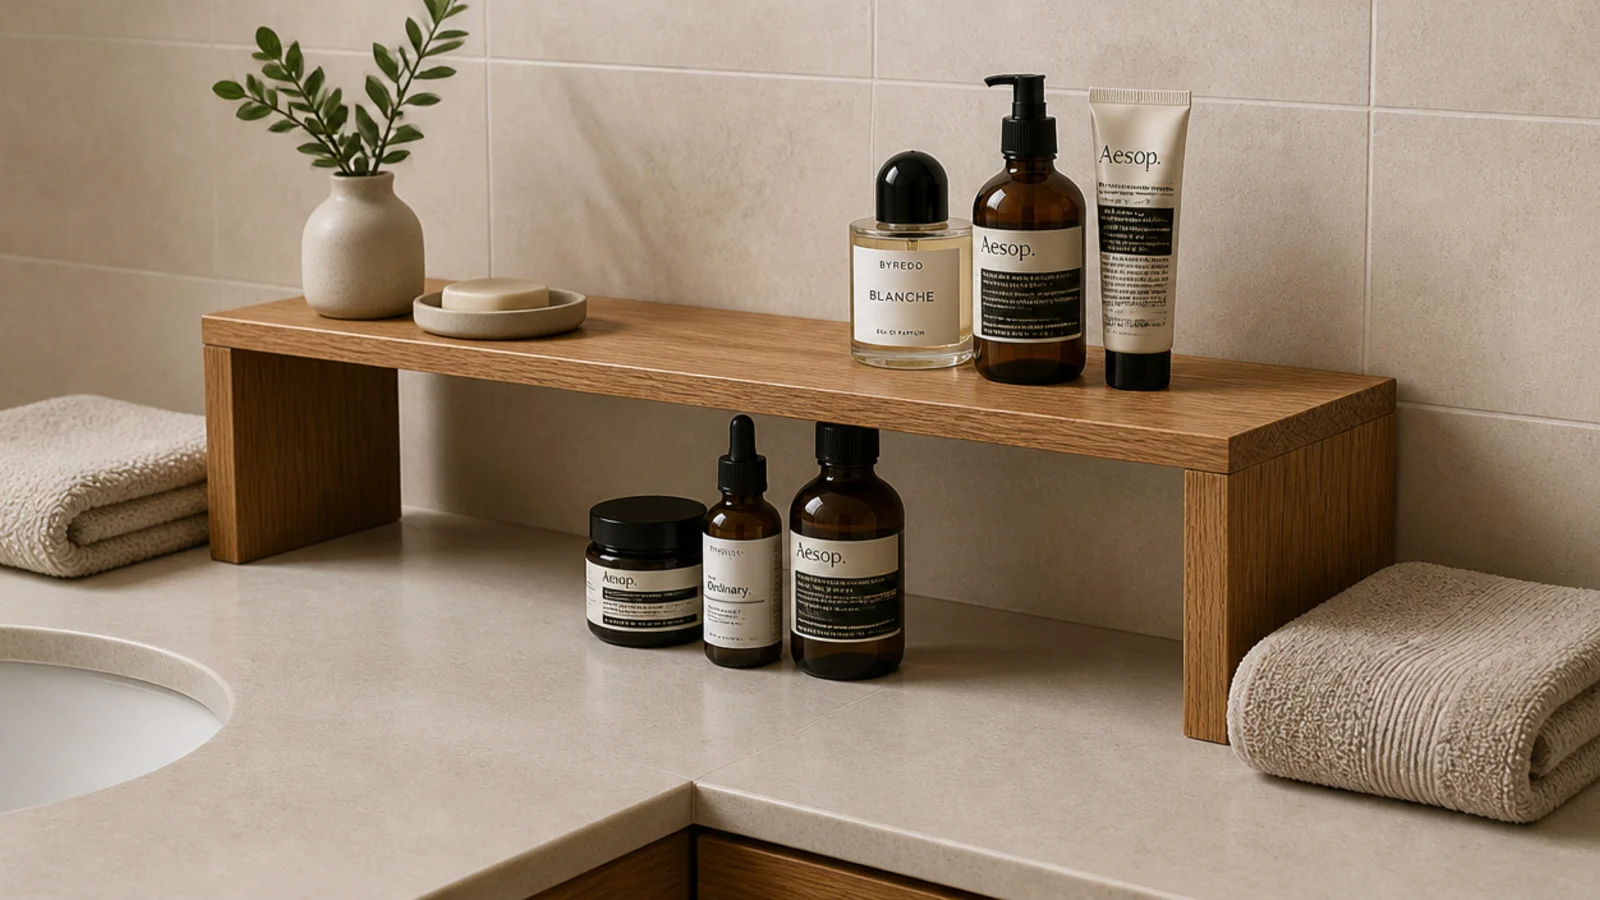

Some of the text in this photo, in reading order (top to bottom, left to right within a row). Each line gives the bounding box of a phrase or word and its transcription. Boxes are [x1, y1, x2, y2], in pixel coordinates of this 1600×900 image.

[1098, 145, 1161, 172] Aesop.
[980, 235, 1035, 262] Aesop.
[879, 260, 923, 270] BYREDO
[869, 289, 935, 303] BLANCHE
[796, 541, 846, 568] Aesop.
[707, 581, 751, 599] Ordinary.
